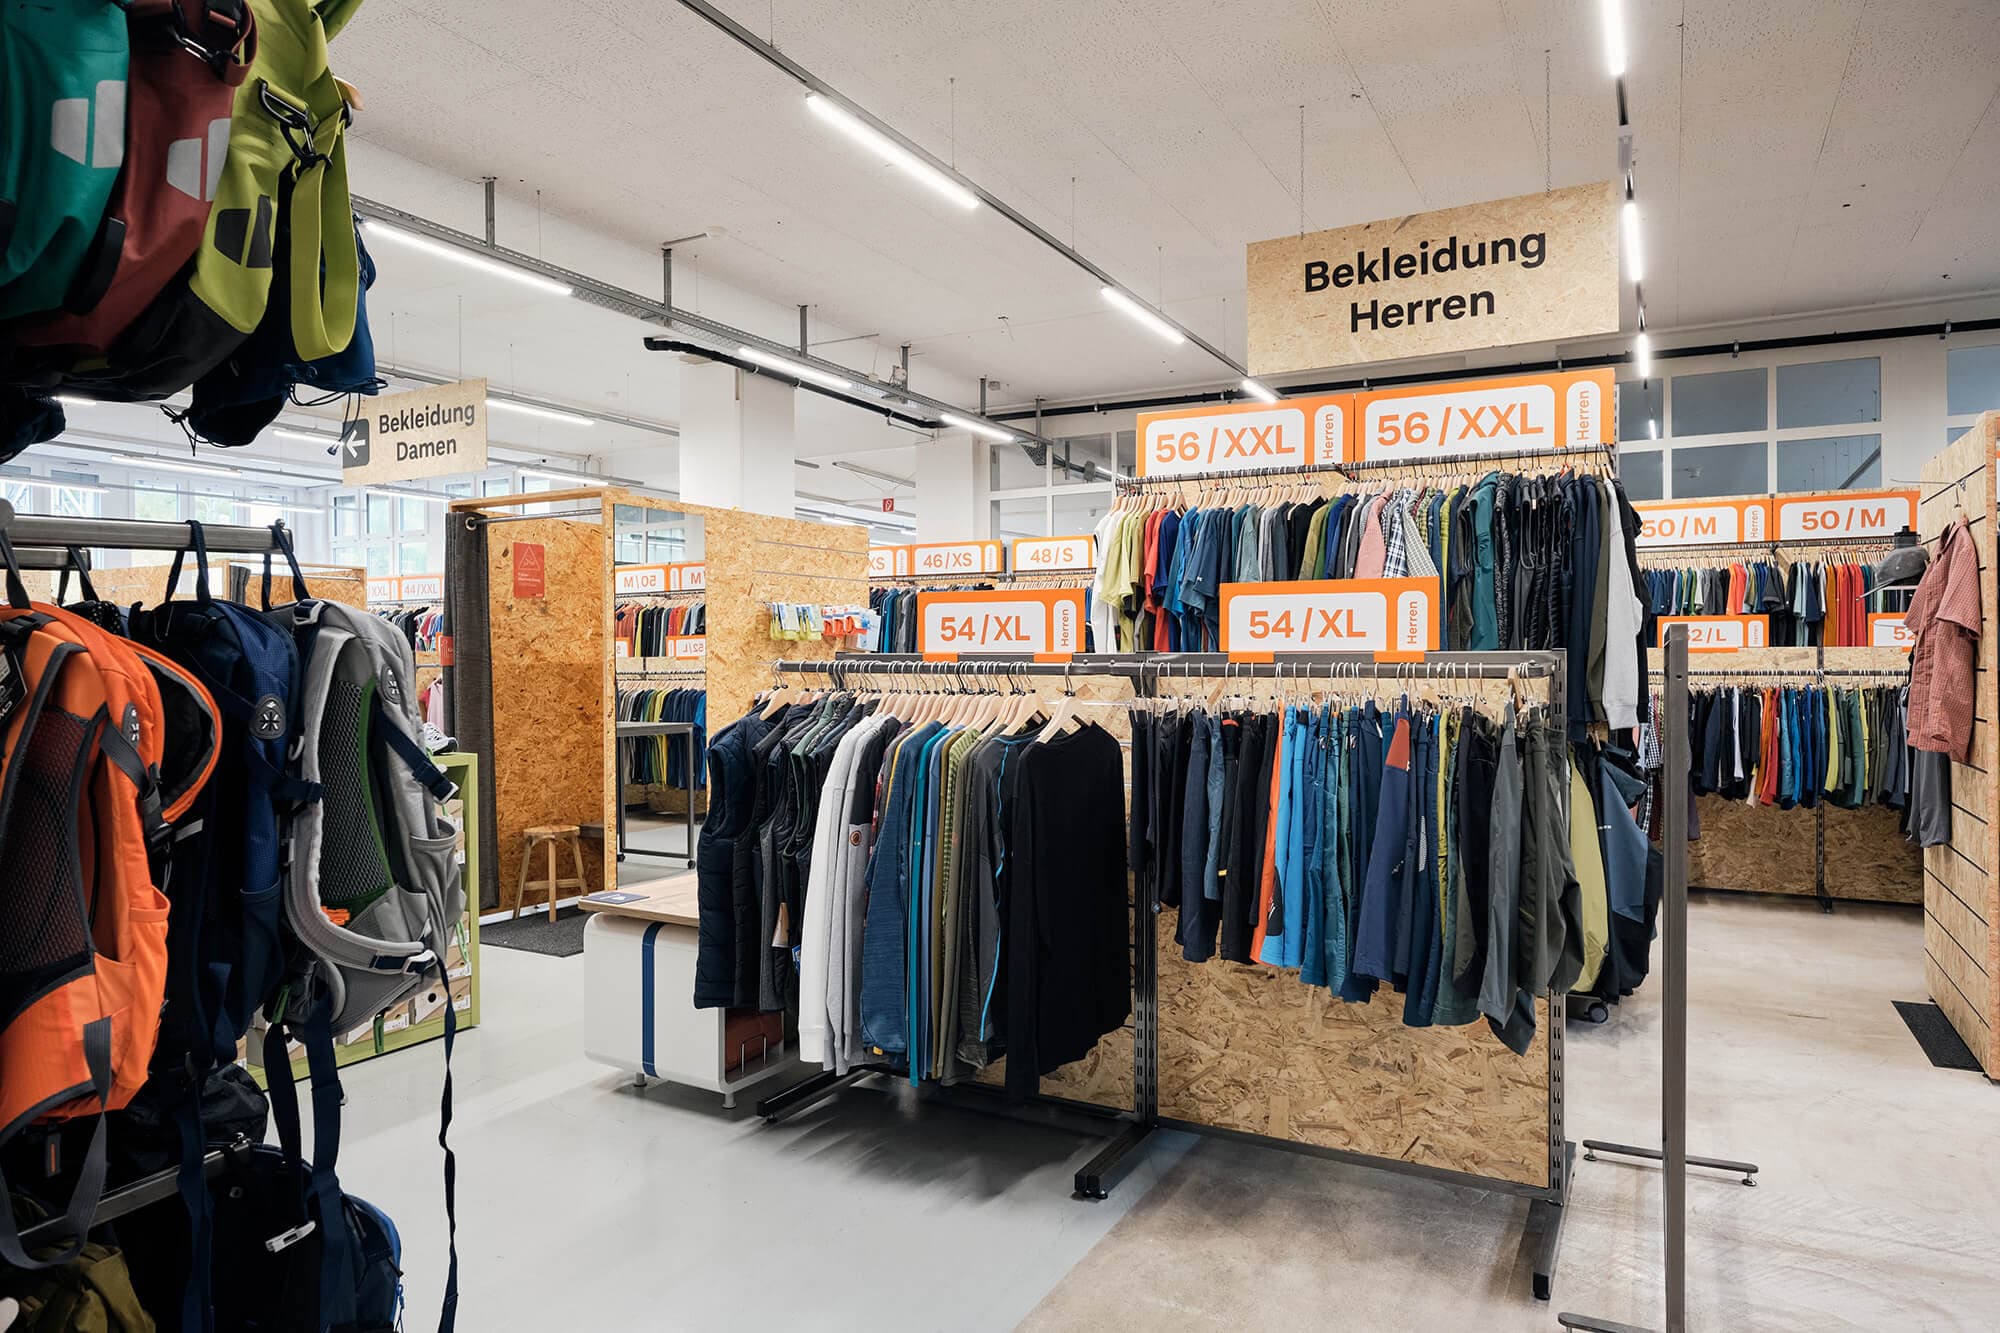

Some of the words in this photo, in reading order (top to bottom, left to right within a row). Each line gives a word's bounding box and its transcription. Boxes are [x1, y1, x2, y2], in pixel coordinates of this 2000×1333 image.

[1304, 231, 1546, 293] Bekleidung
[1350, 290, 1495, 333] Herren
[379, 403, 475, 434] Bekleidung
[1377, 402, 1544, 447] 56/XXL
[1576, 390, 1590, 441] Herren
[396, 438, 457, 461] Damen
[1155, 424, 1296, 464] 56/XXL
[1322, 413, 1334, 459] Herren
[1642, 515, 1717, 539] 50/M
[1750, 510, 1759, 538] Herren
[1801, 507, 1886, 532] 50/M
[923, 551, 973, 569] 46/XS
[1030, 546, 1074, 566] 48/S
[940, 614, 1031, 645] 54/XL
[1061, 608, 1069, 647] Herren
[1248, 607, 1367, 643] 54/XL
[1407, 600, 1418, 645] Herren
